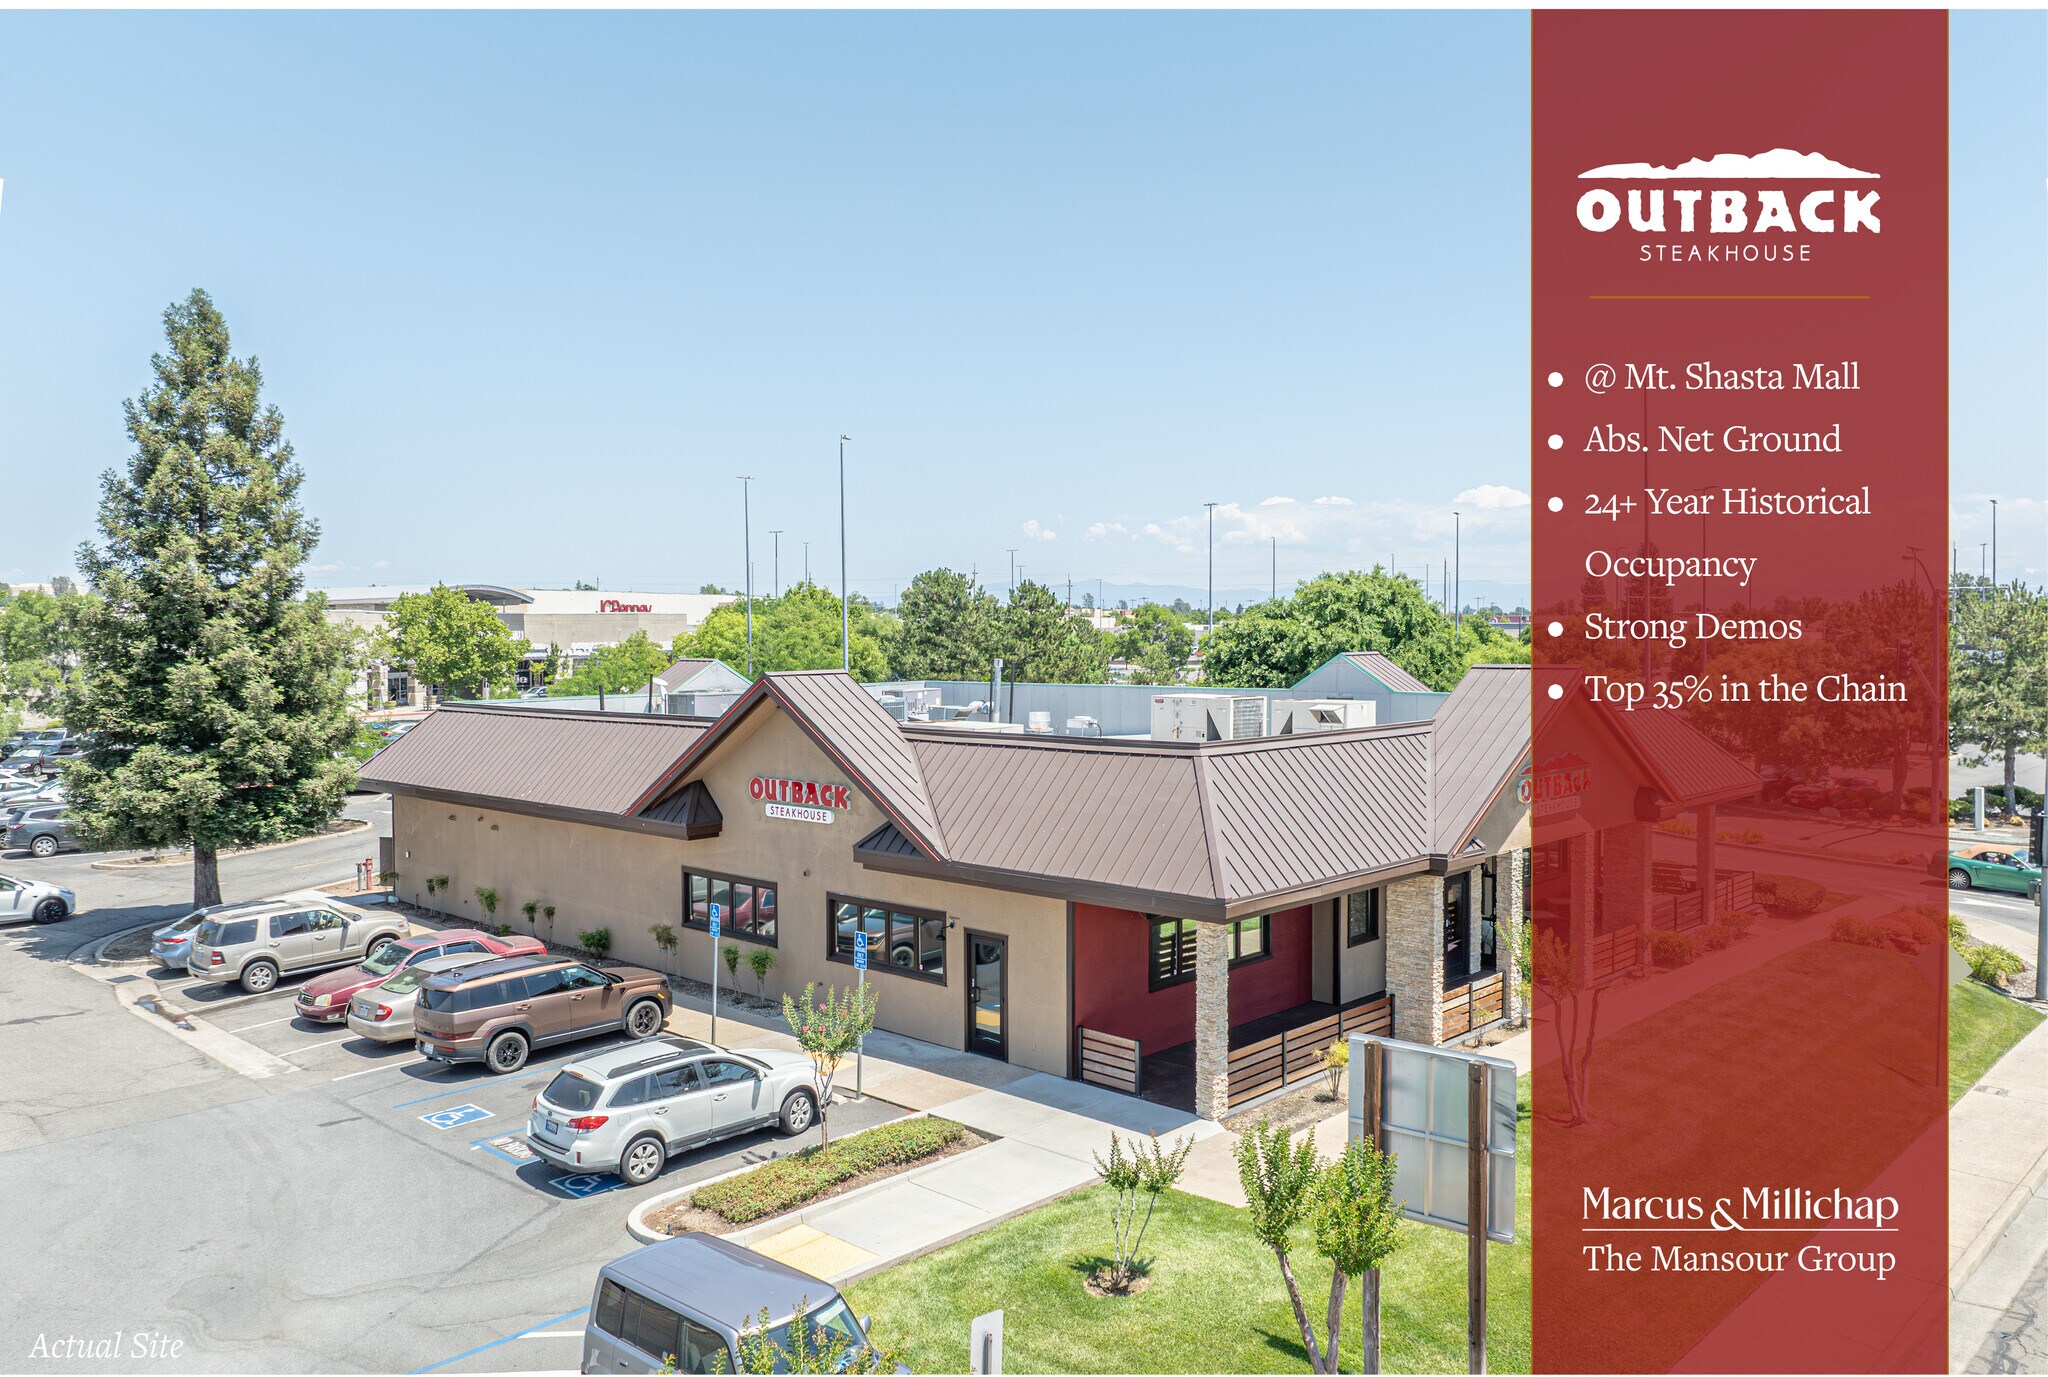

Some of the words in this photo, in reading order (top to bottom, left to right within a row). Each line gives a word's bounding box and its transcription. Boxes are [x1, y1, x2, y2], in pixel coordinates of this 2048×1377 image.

[749, 776, 851, 811] OUTBACK
[1516, 767, 1592, 805] OUTBACK
[770, 805, 827, 822] STEAKHOUSE
